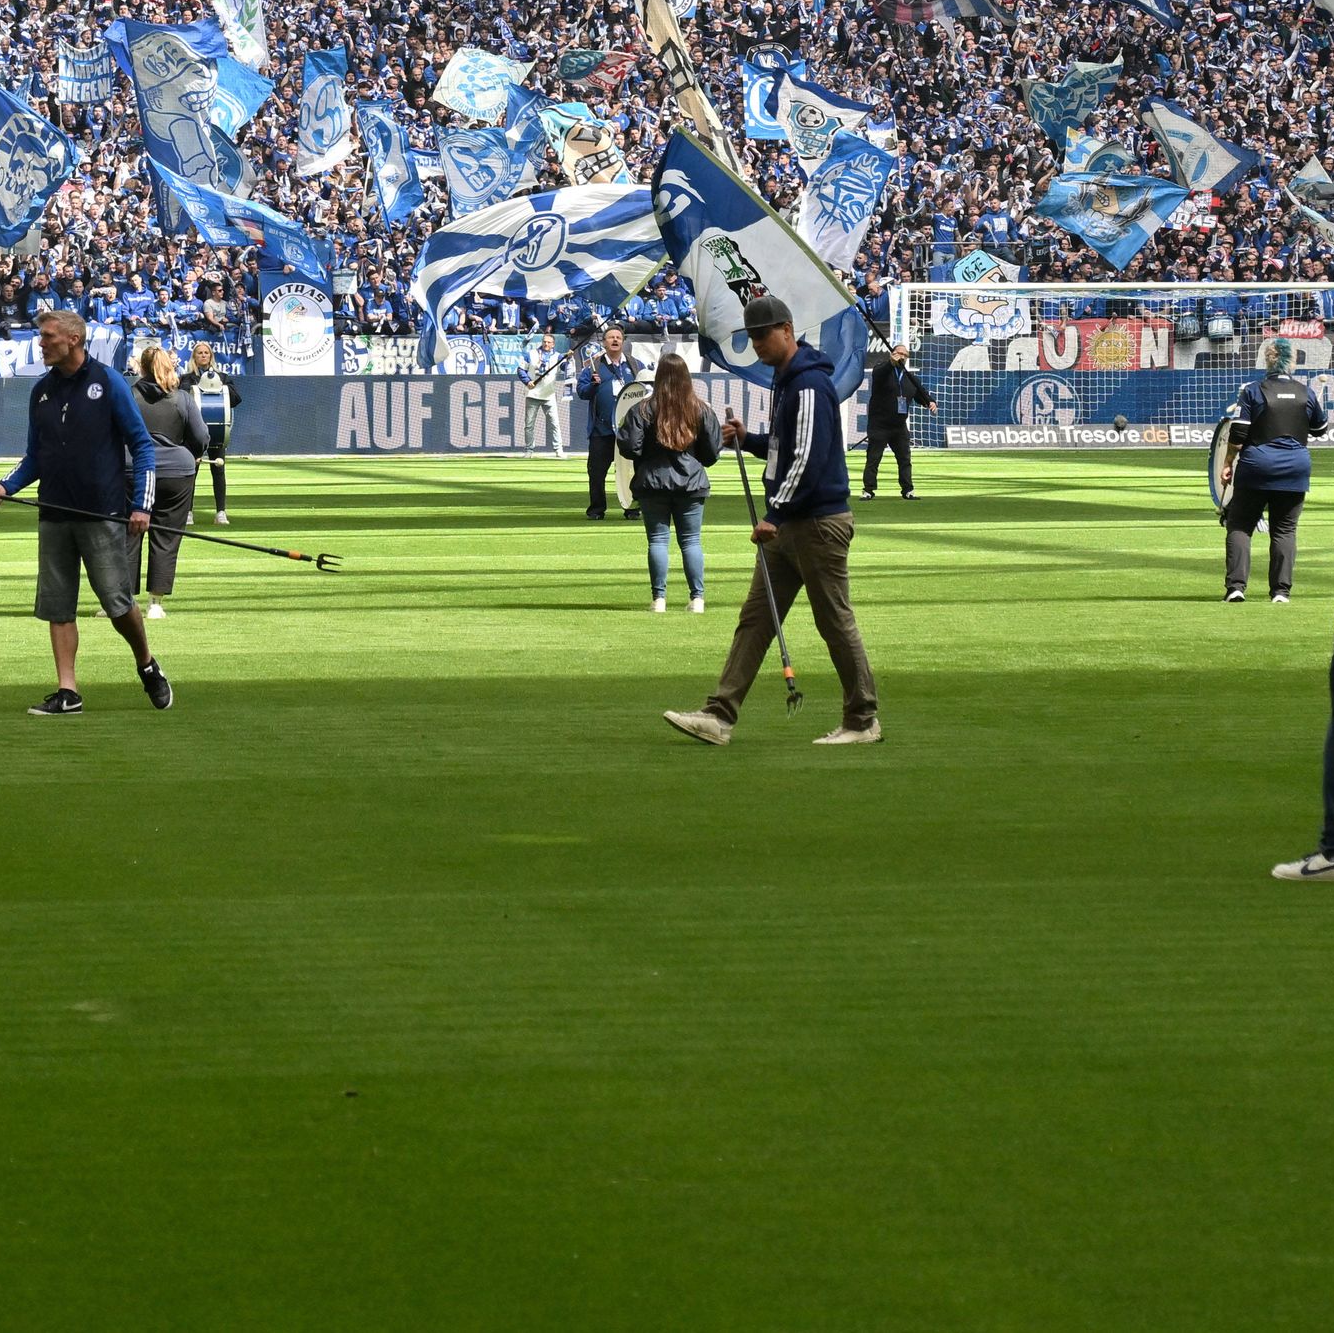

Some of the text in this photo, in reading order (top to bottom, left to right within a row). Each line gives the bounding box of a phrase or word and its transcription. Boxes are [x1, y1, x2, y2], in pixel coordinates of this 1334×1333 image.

[267, 283, 326, 305] ULTRAS
[336, 381, 433, 448] AUF
[947, 425, 1057, 445] Eisenbach
[1062, 425, 1169, 444] Tresore.de
